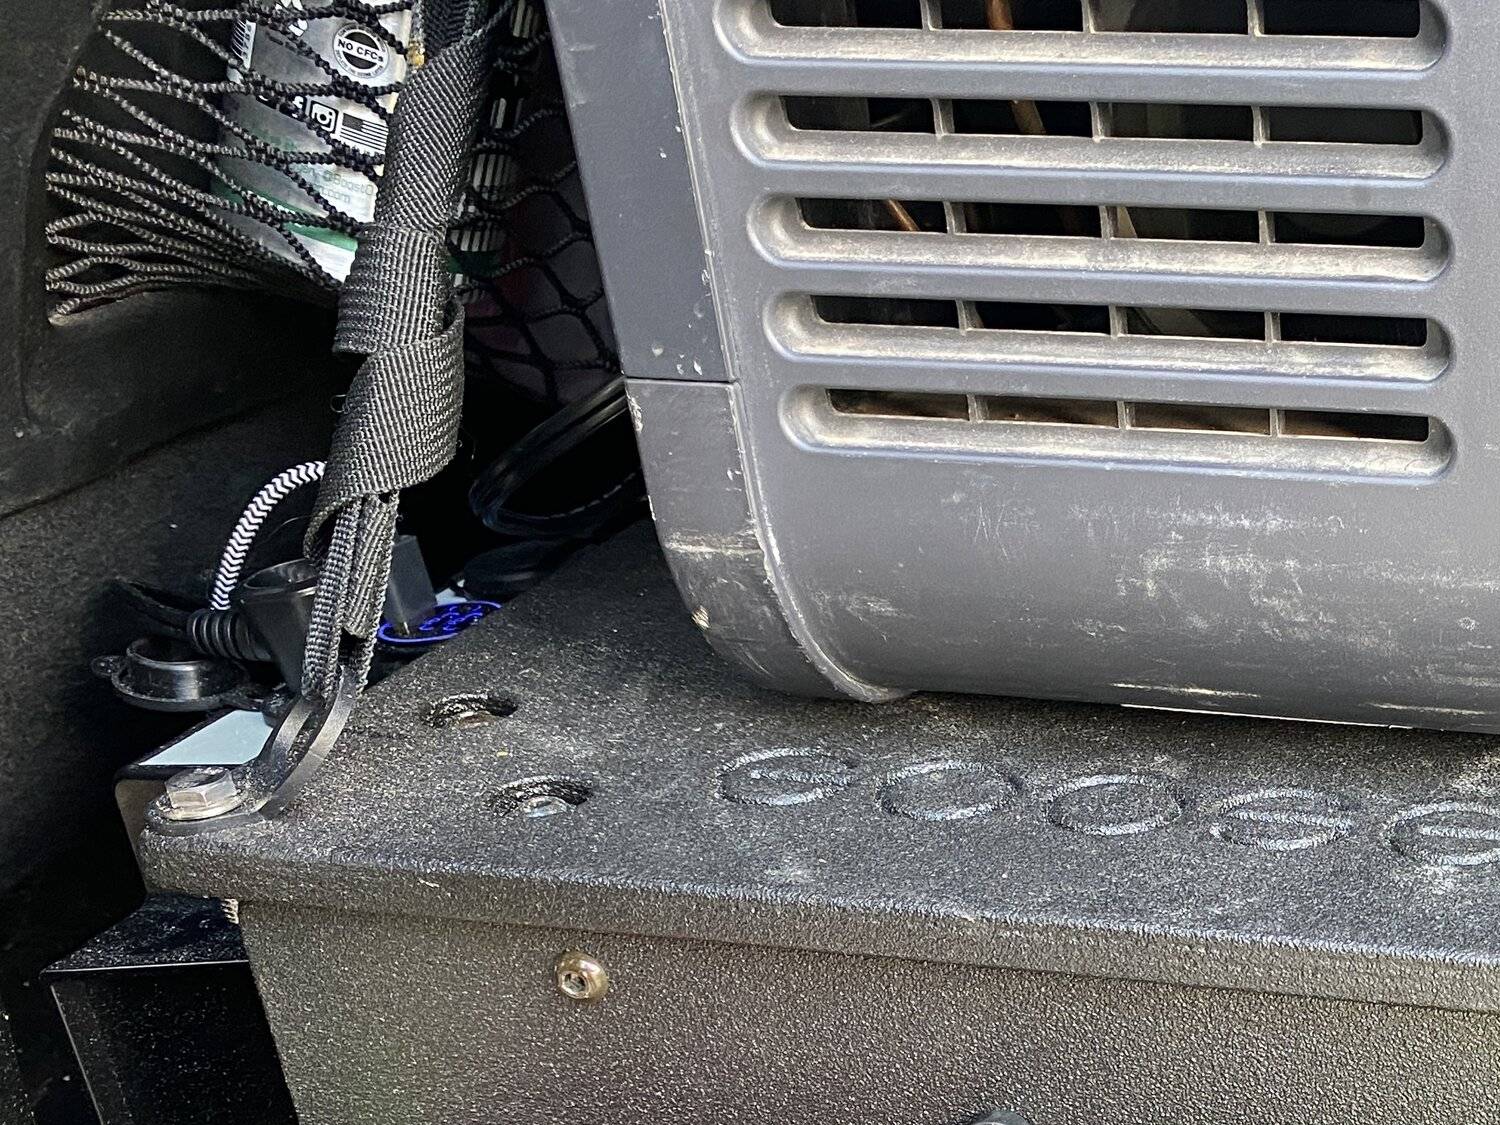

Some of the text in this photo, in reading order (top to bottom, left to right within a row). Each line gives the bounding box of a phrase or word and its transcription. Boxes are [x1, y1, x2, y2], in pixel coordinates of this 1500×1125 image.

[338, 38, 354, 51] NO
[356, 46, 384, 62] CFCs
[322, 169, 374, 196] @BoostO
